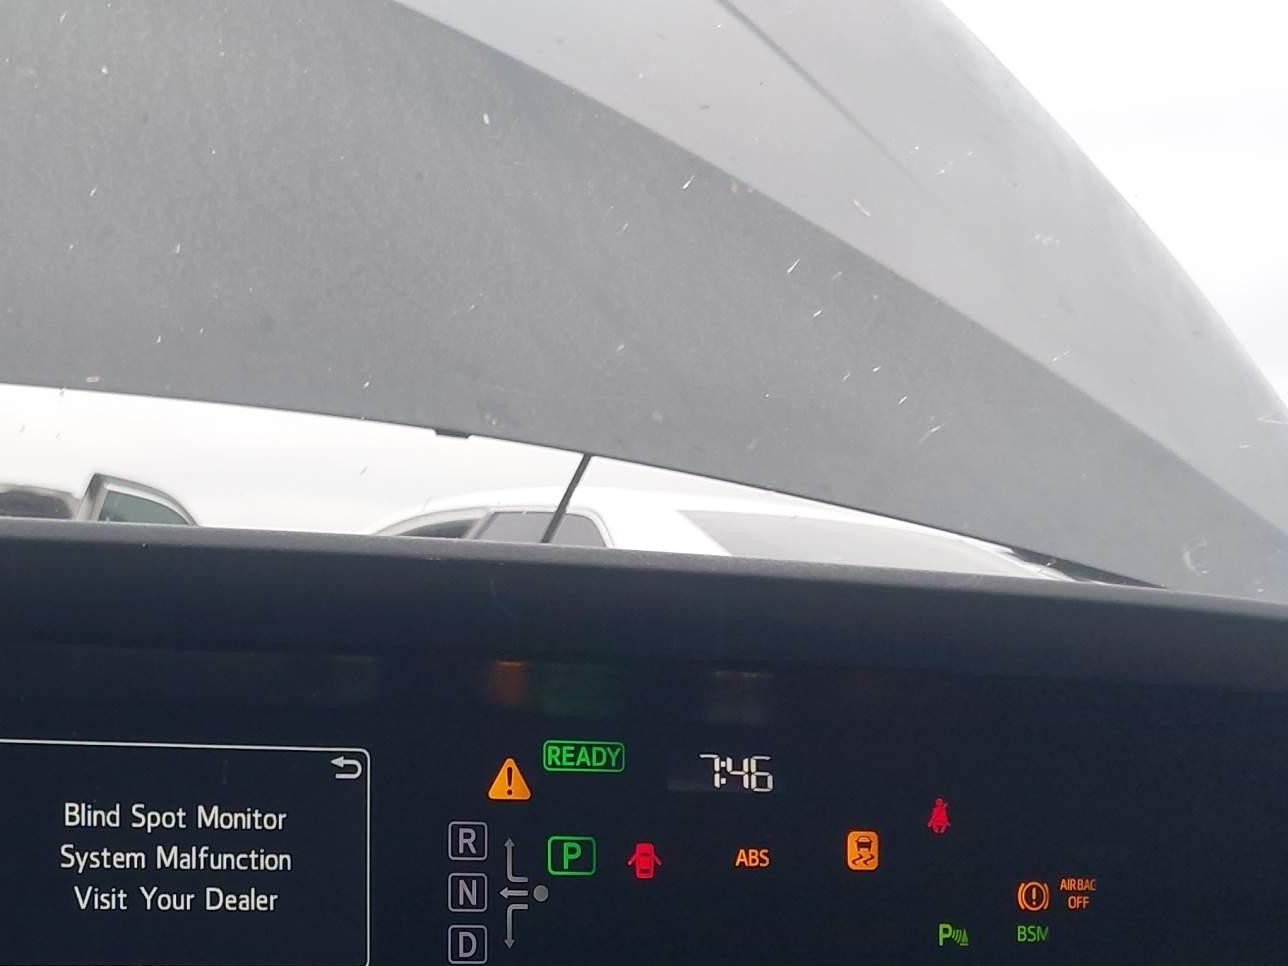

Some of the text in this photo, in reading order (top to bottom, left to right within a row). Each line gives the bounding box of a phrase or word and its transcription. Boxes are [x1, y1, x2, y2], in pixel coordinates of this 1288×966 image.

[546, 745, 622, 767] READY
[698, 753, 775, 793] 7:46
[63, 802, 287, 832] Blind Spot Monitor
[458, 827, 477, 854] R
[59, 844, 292, 874] System Malfunction
[563, 842, 583, 869] P
[735, 848, 771, 868] ABS
[74, 886, 279, 912] Visit Your Dealer
[458, 879, 478, 906] N
[1067, 895, 1090, 910] OFF
[458, 931, 478, 958] D
